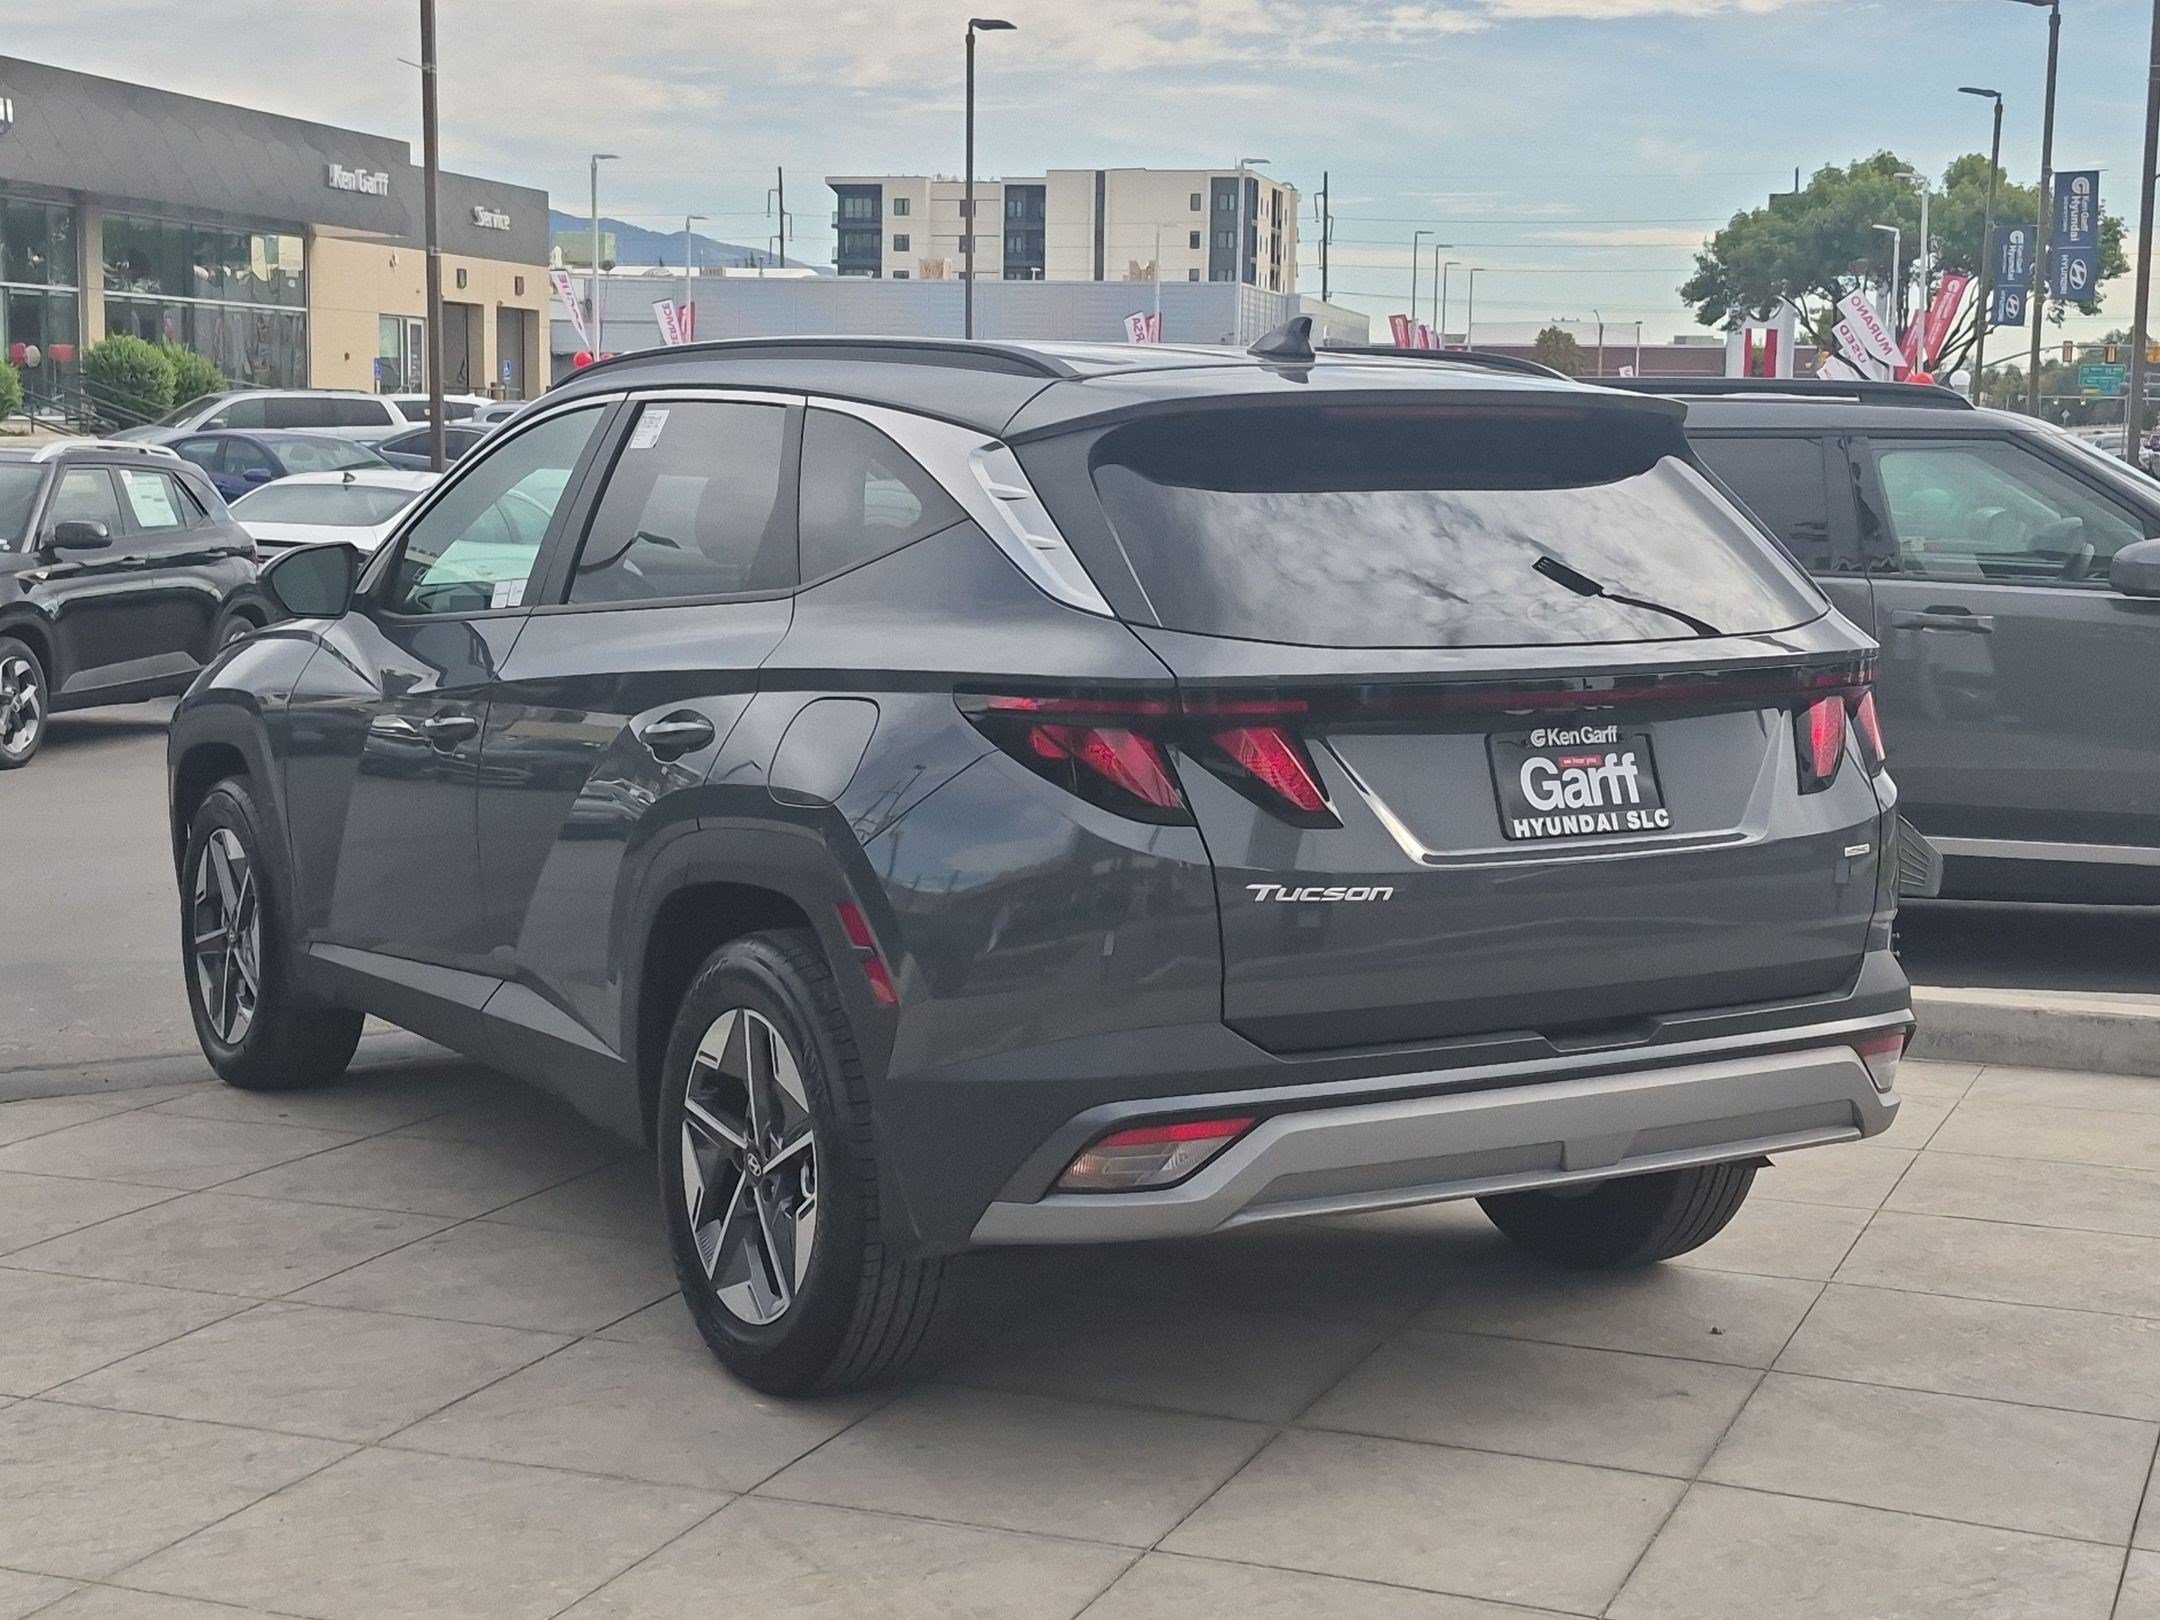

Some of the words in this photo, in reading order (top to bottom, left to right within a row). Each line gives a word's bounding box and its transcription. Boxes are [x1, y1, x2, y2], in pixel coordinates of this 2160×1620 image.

[329, 163, 356, 190] Ken
[355, 169, 389, 197] Garff
[473, 206, 511, 231] Service
[2070, 195, 2080, 242] Hyundai
[1547, 727, 1580, 746] Ken
[1580, 725, 1618, 744] Garff
[1520, 752, 1641, 811] Garff
[1513, 811, 1619, 838] HYUNDAI
[1626, 808, 1670, 830] SLC
